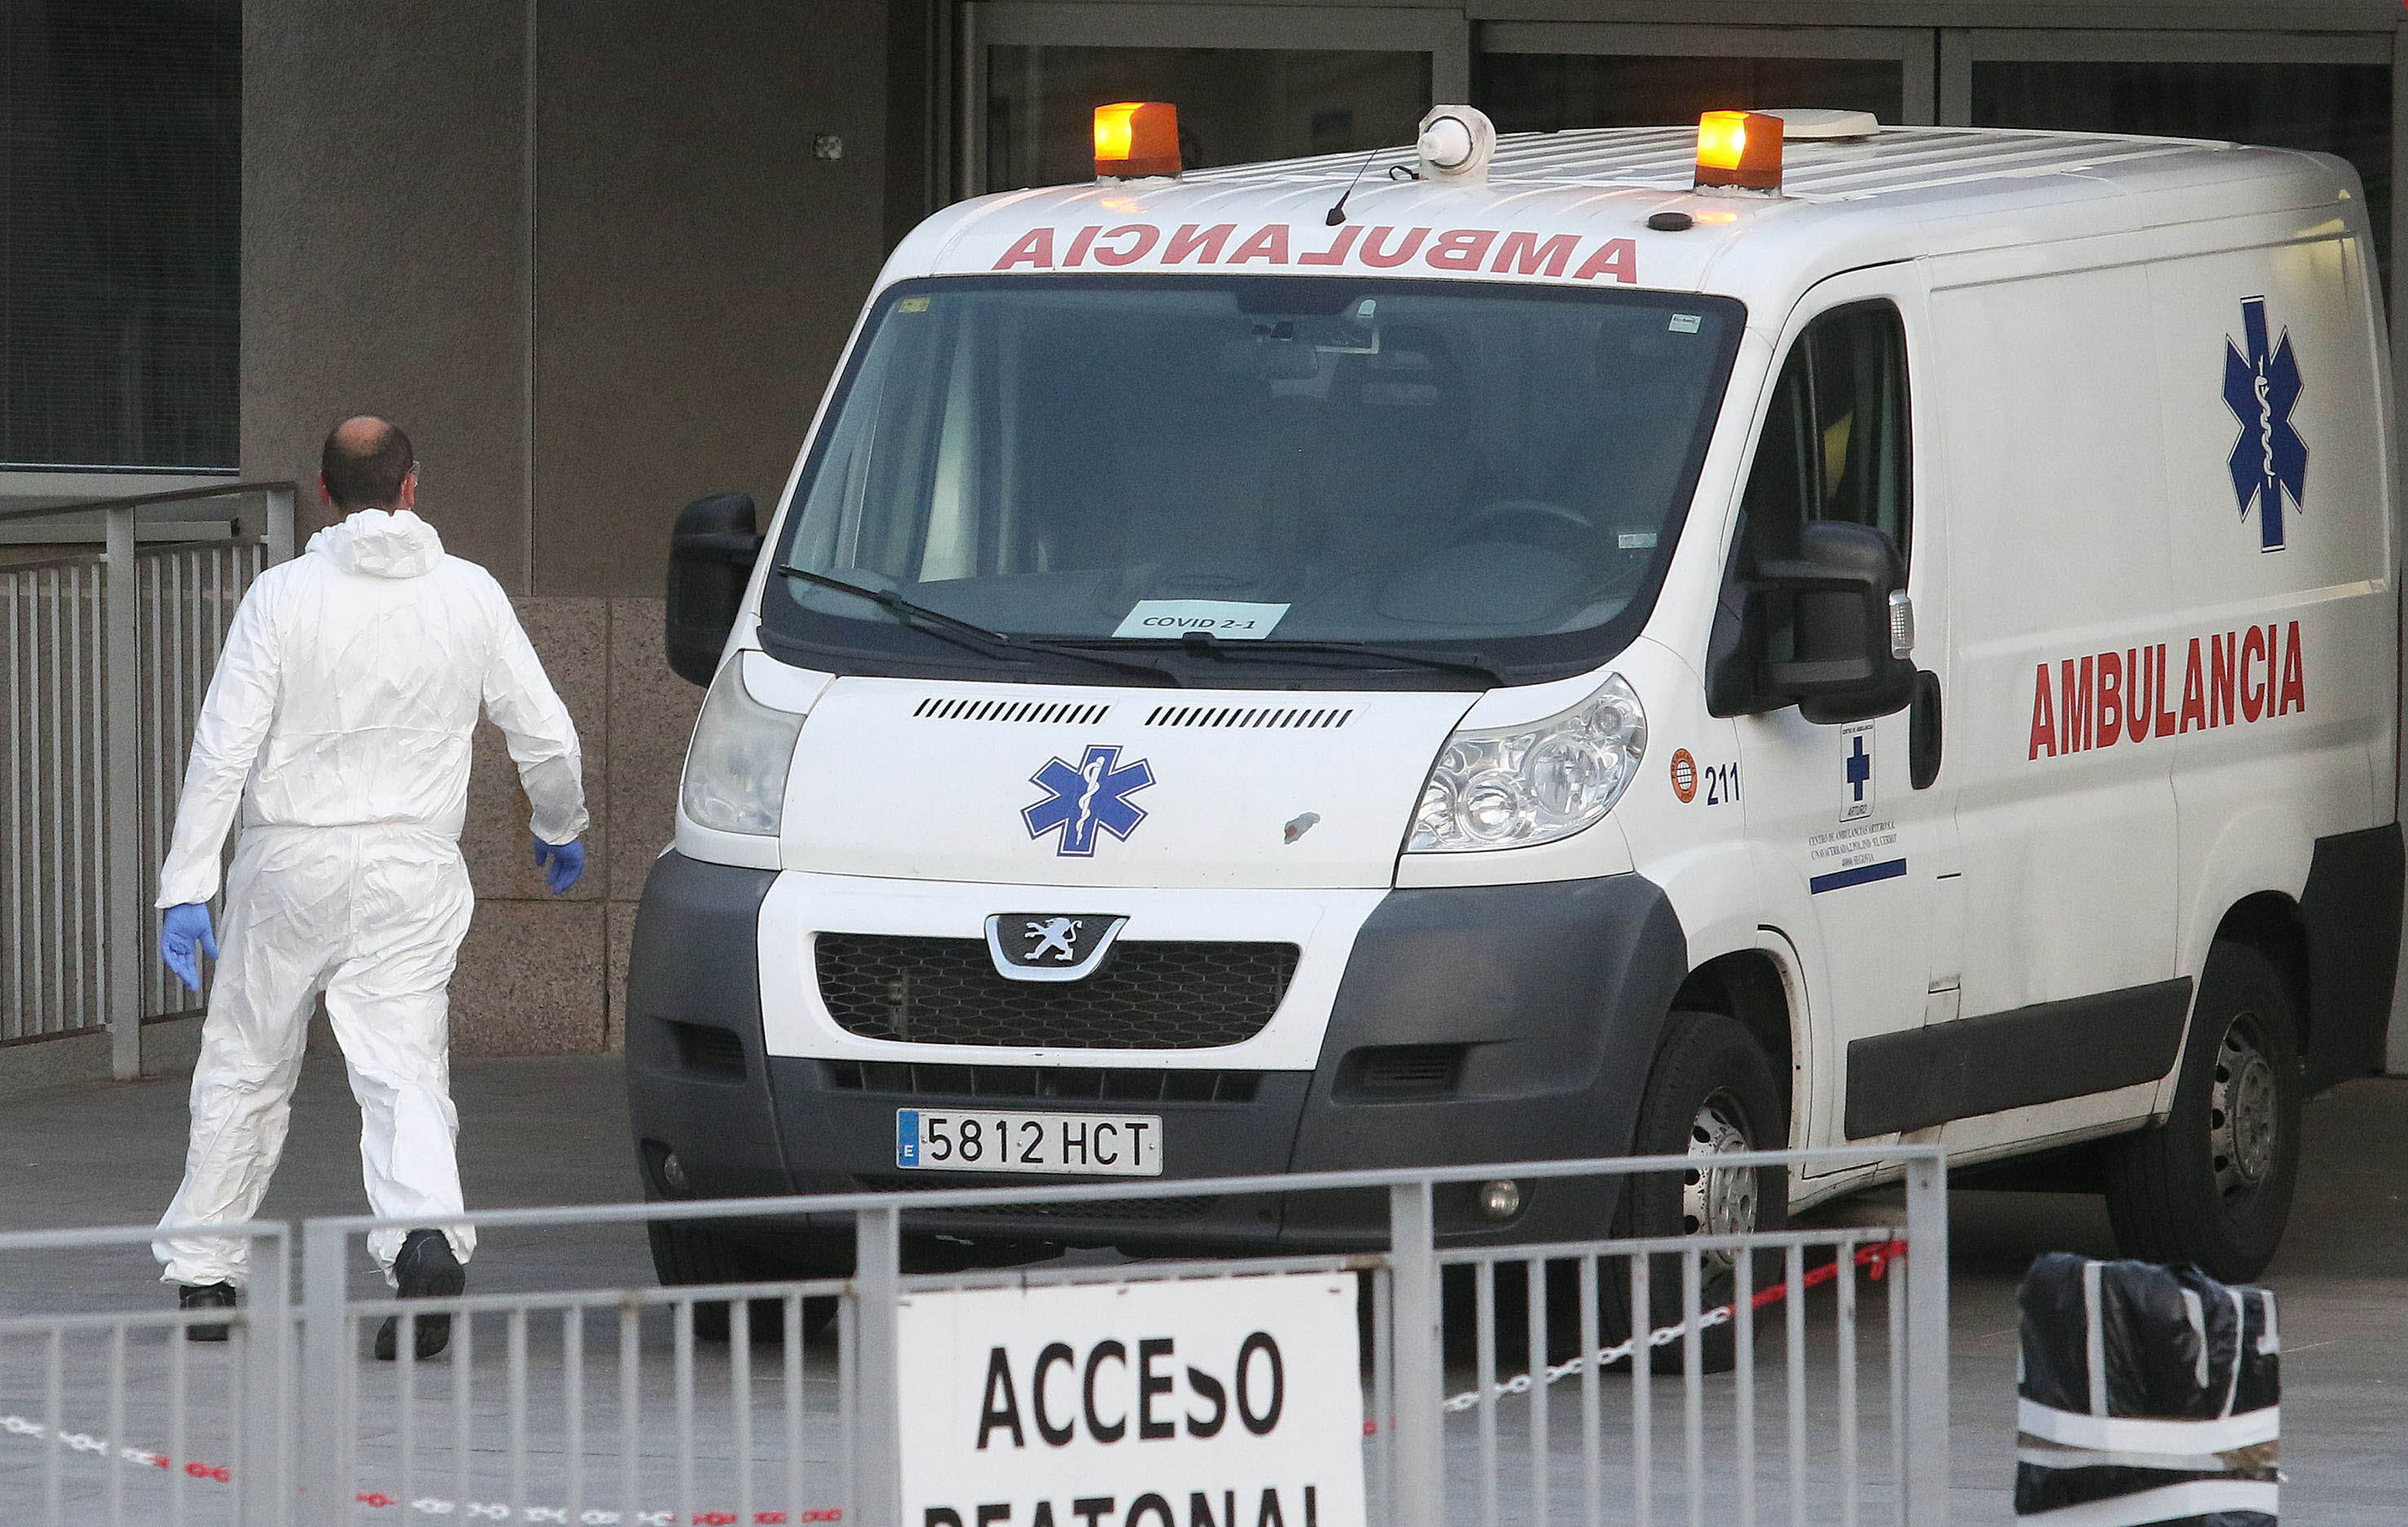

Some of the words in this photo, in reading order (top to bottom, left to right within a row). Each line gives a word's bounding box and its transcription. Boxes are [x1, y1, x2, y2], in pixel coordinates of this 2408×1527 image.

[1142, 617, 1216, 628] COVID
[1220, 619, 1257, 630] 2-1
[2028, 620, 2305, 761] AMBULANCIA
[1705, 761, 1740, 806] 211
[1848, 803, 1867, 817] ARTURO
[903, 1144, 915, 1157] E
[928, 1118, 1045, 1164] 5812
[1063, 1122, 1149, 1166] HCT
[976, 1331, 1285, 1450] ACCESO
